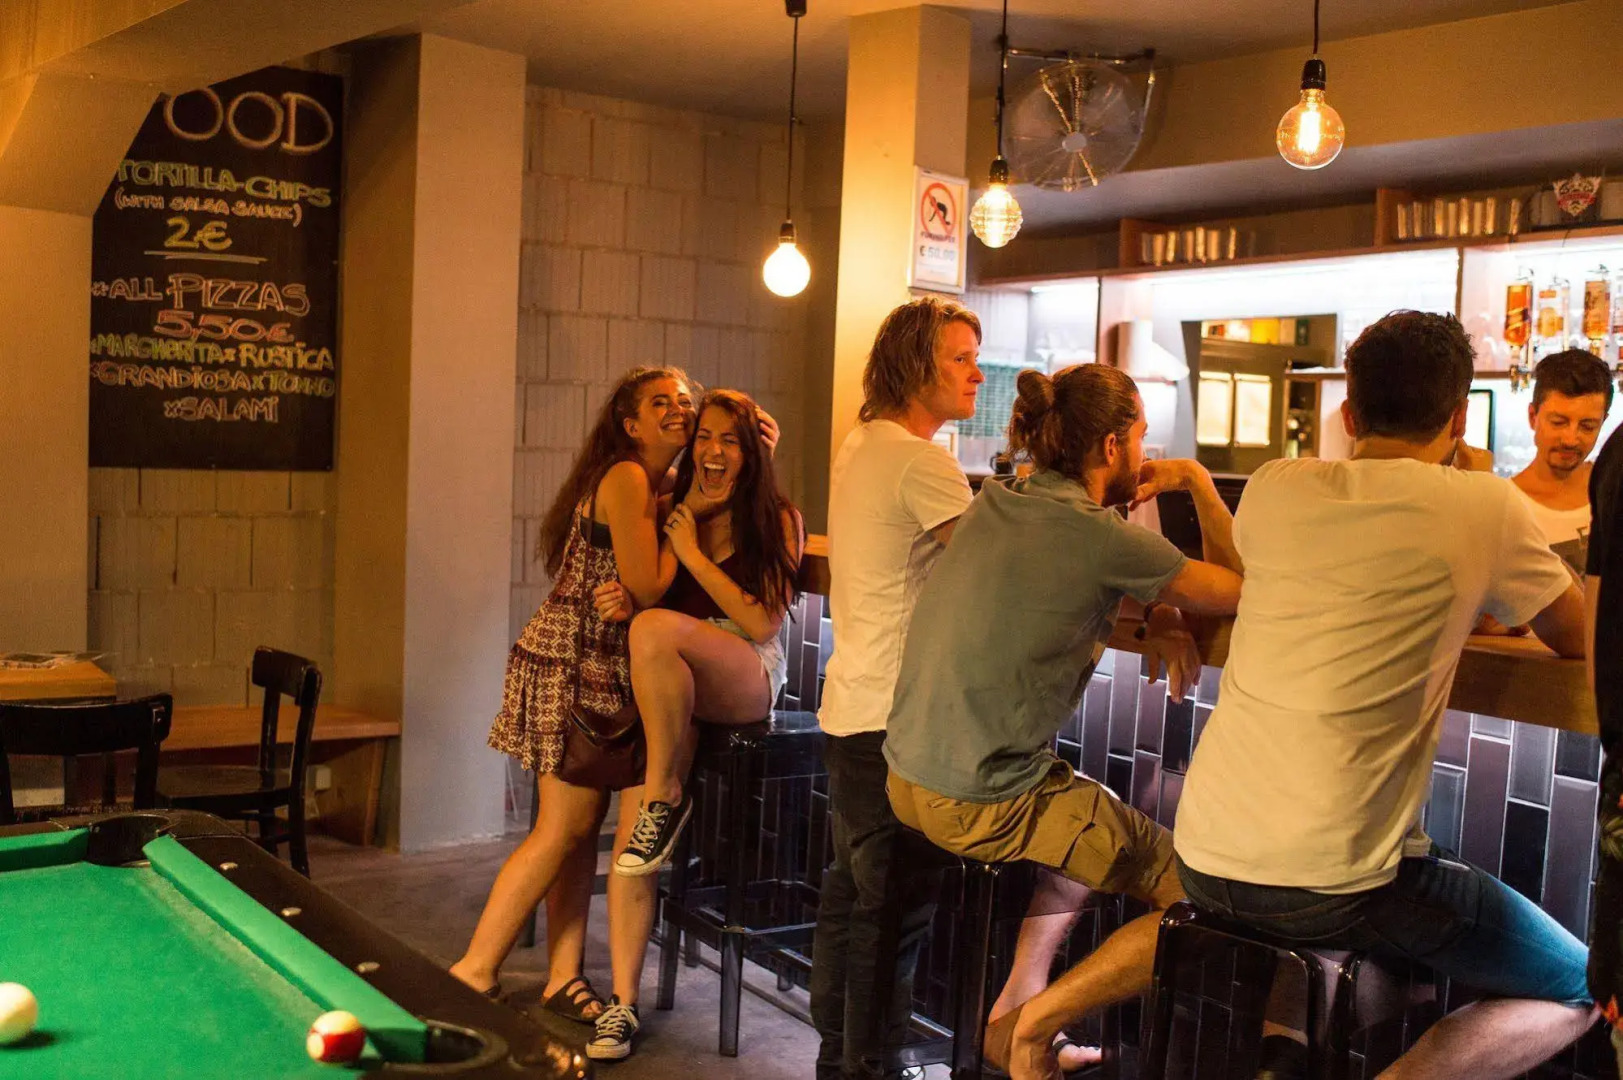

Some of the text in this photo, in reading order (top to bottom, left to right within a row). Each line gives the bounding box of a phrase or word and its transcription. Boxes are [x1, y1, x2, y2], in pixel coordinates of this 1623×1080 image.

[163, 87, 334, 155] OOD
[169, 196, 230, 215] SALSA
[164, 216, 232, 251] 2€
[109, 273, 310, 316] ALL PIZZAS
[154, 310, 294, 345] 5,50€
[238, 341, 334, 371] RUSTICA
[177, 396, 279, 422] SALAMI
